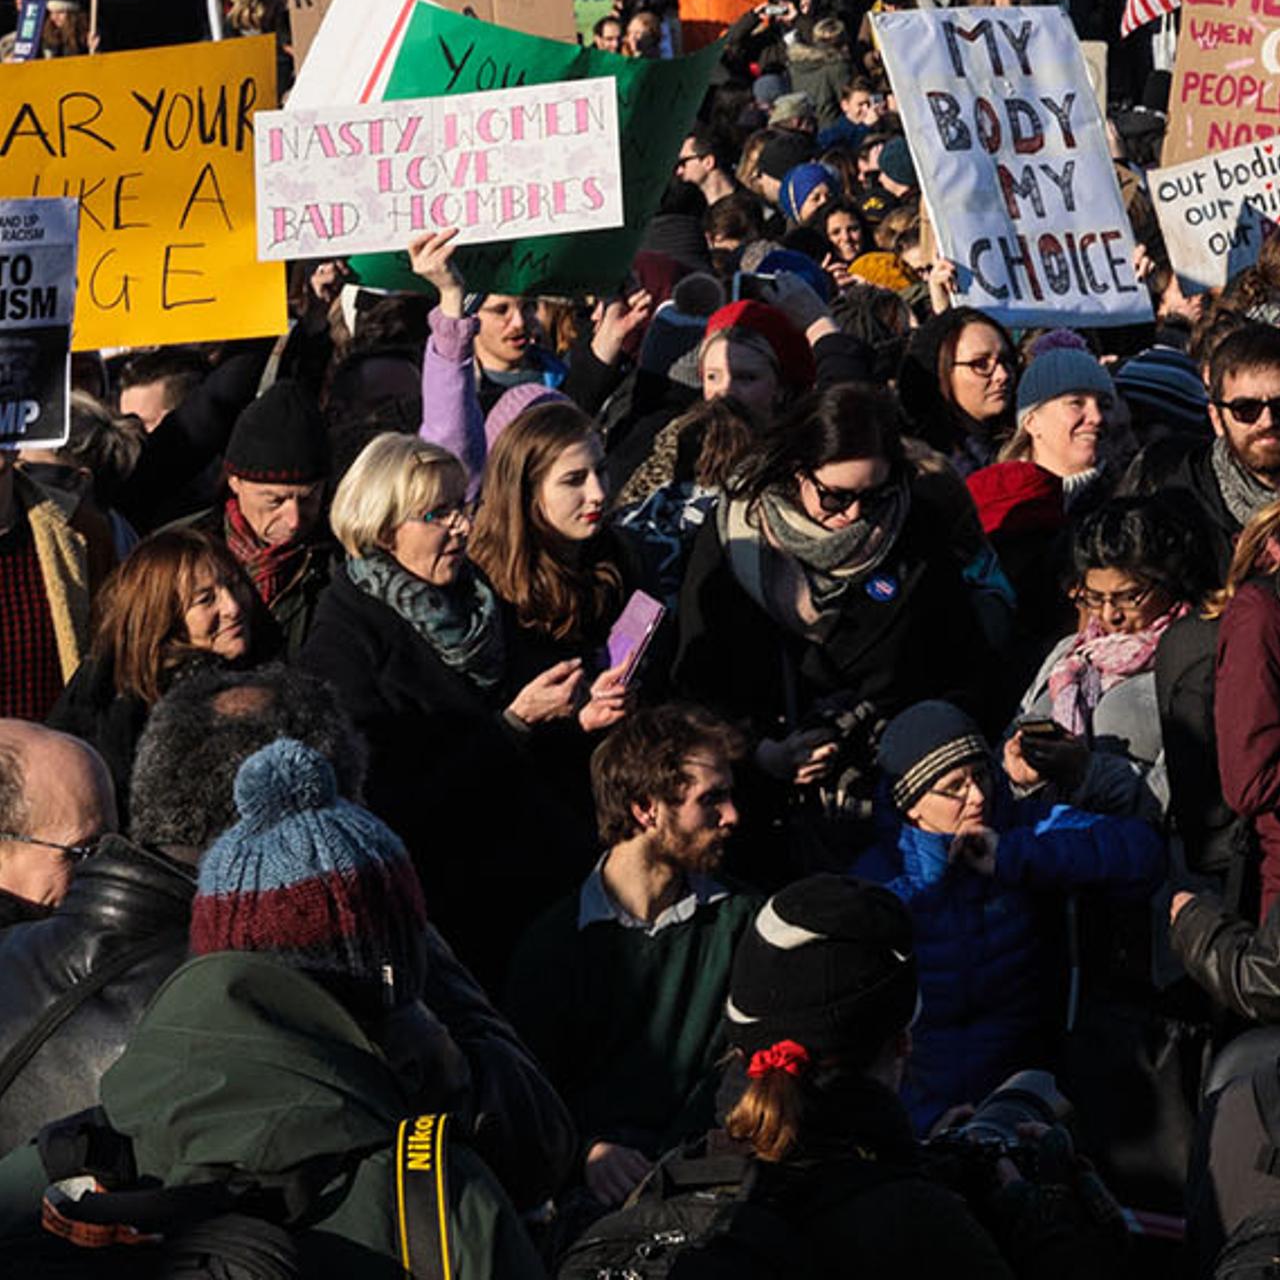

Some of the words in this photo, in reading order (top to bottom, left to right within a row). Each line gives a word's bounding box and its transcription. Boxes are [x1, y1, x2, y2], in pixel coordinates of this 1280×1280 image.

[942, 18, 1033, 78] MY
[1190, 17, 1254, 44] WHEN
[131, 77, 258, 153] YOUR
[268, 115, 424, 164] NASTY
[443, 95, 607, 148] WOMEN
[926, 90, 1077, 155] BODY
[179, 162, 234, 231] A
[376, 149, 494, 194] LOVE
[996, 160, 1075, 220] MY
[1158, 171, 1207, 202] our
[1, 228, 45, 241] RACISM
[23, 214, 40, 228] UP
[268, 202, 361, 249] BAD
[388, 175, 606, 232] HOMBRES
[1184, 197, 1235, 226] our
[1208, 223, 1256, 256] our
[969, 230, 1139, 302] CHOICE
[407, 1113, 437, 1171] Niko
